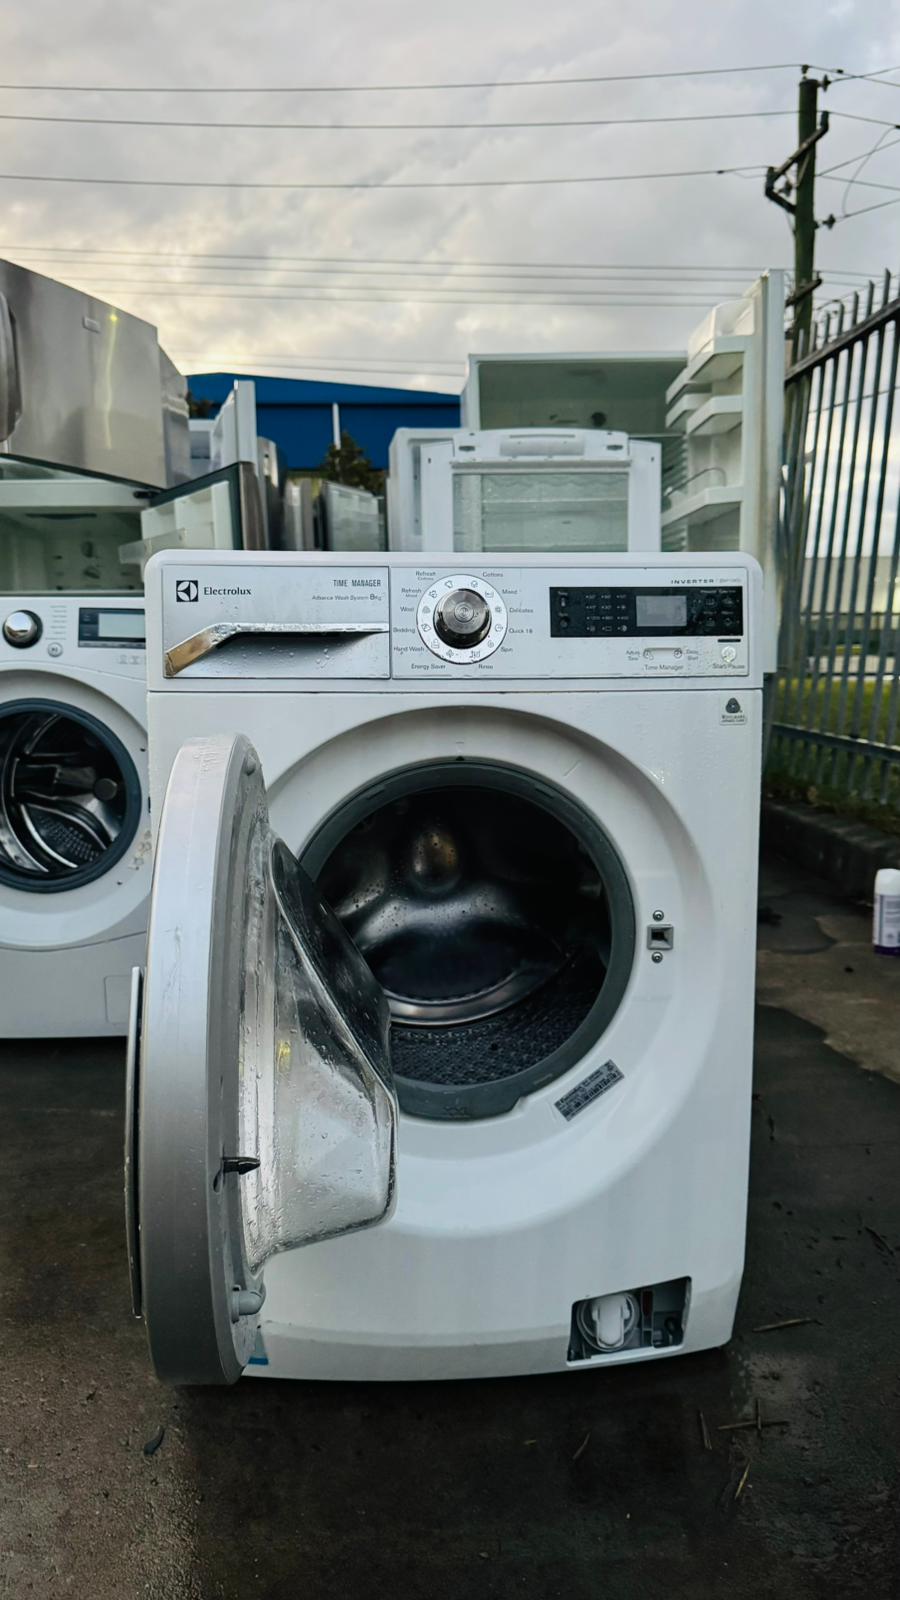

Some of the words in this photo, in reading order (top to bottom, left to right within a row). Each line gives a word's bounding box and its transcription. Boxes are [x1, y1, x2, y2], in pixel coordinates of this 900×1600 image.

[333, 579, 348, 587] TIME
[351, 579, 381, 587] MANAGER
[203, 586, 252, 596] Electrolux
[411, 663, 430, 671] Energy
